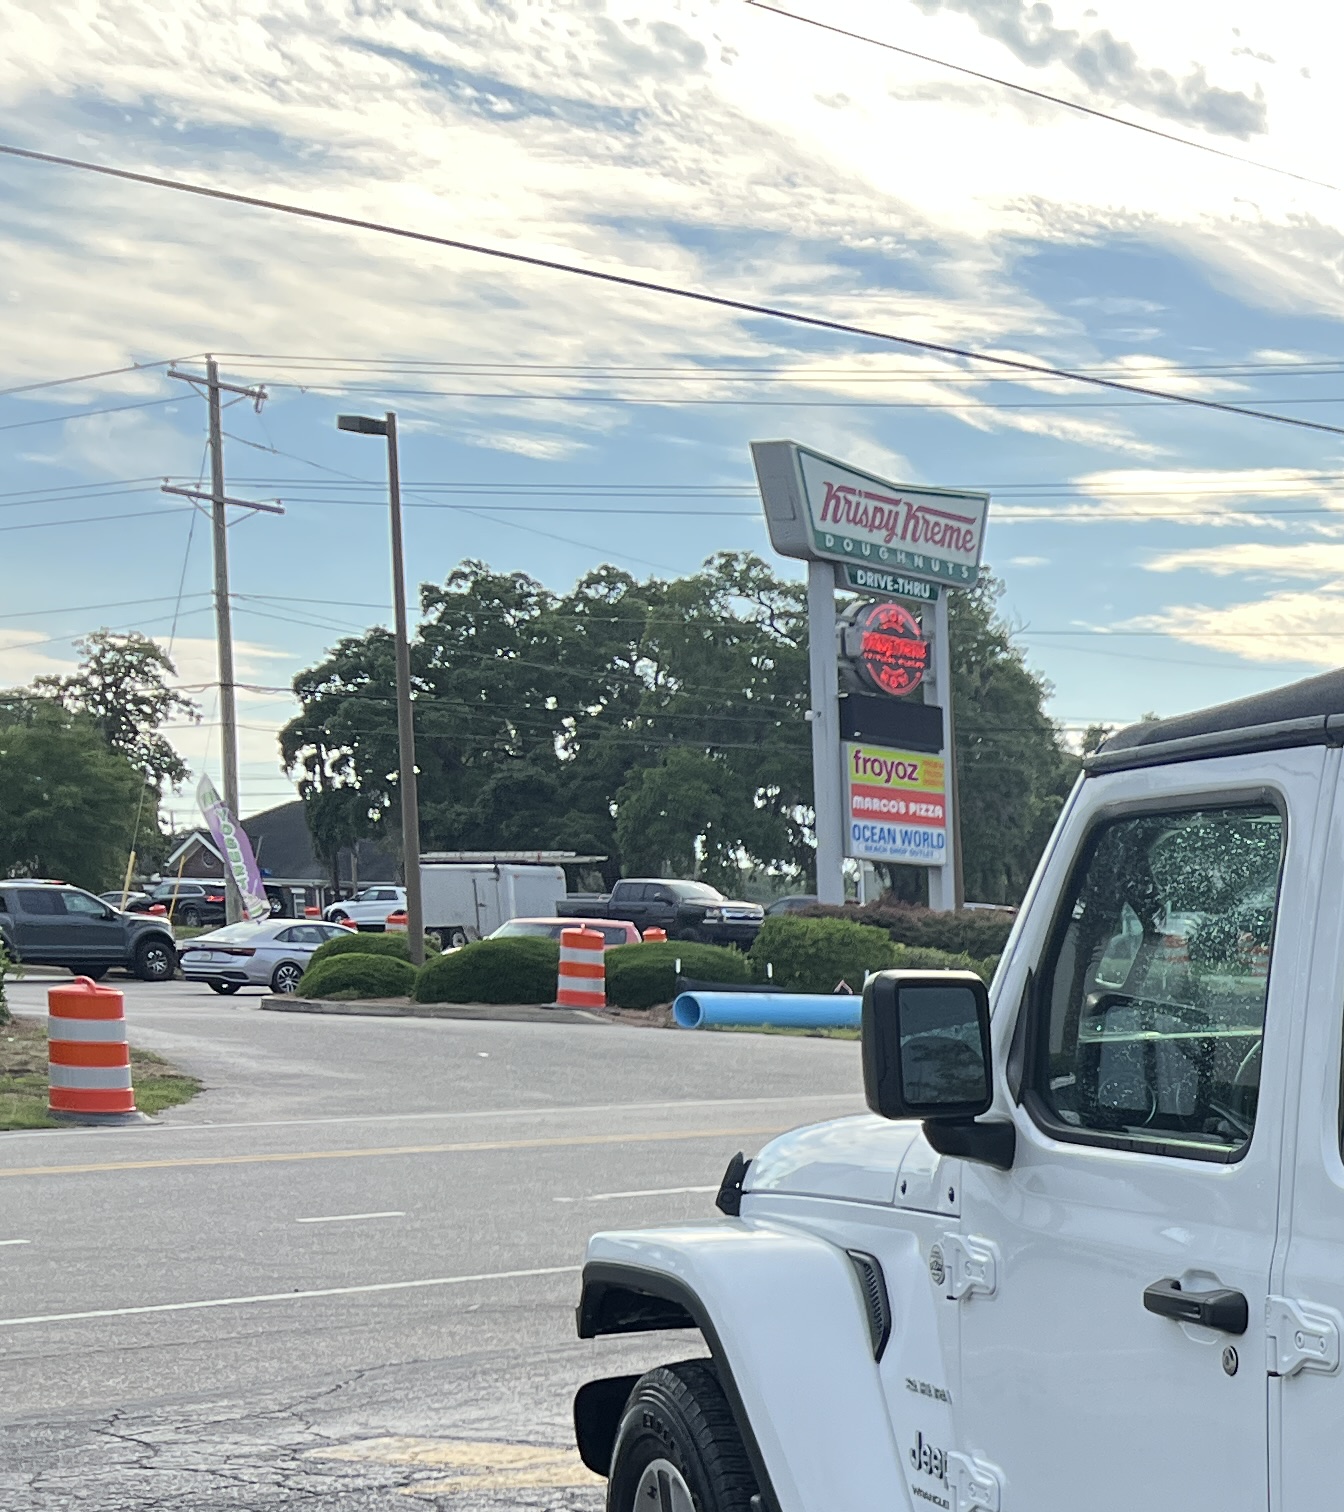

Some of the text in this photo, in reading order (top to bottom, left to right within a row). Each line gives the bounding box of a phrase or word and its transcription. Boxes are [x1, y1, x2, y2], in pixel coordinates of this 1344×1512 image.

[820, 481, 977, 553] Krispy Kreme
[825, 534, 969, 579] DOUGHNUTS
[857, 570, 931, 599] DRIVE-THRU
[853, 749, 919, 784] froyoz
[908, 802, 943, 819] PIZZA
[852, 824, 945, 849] OCEAN WORLD
